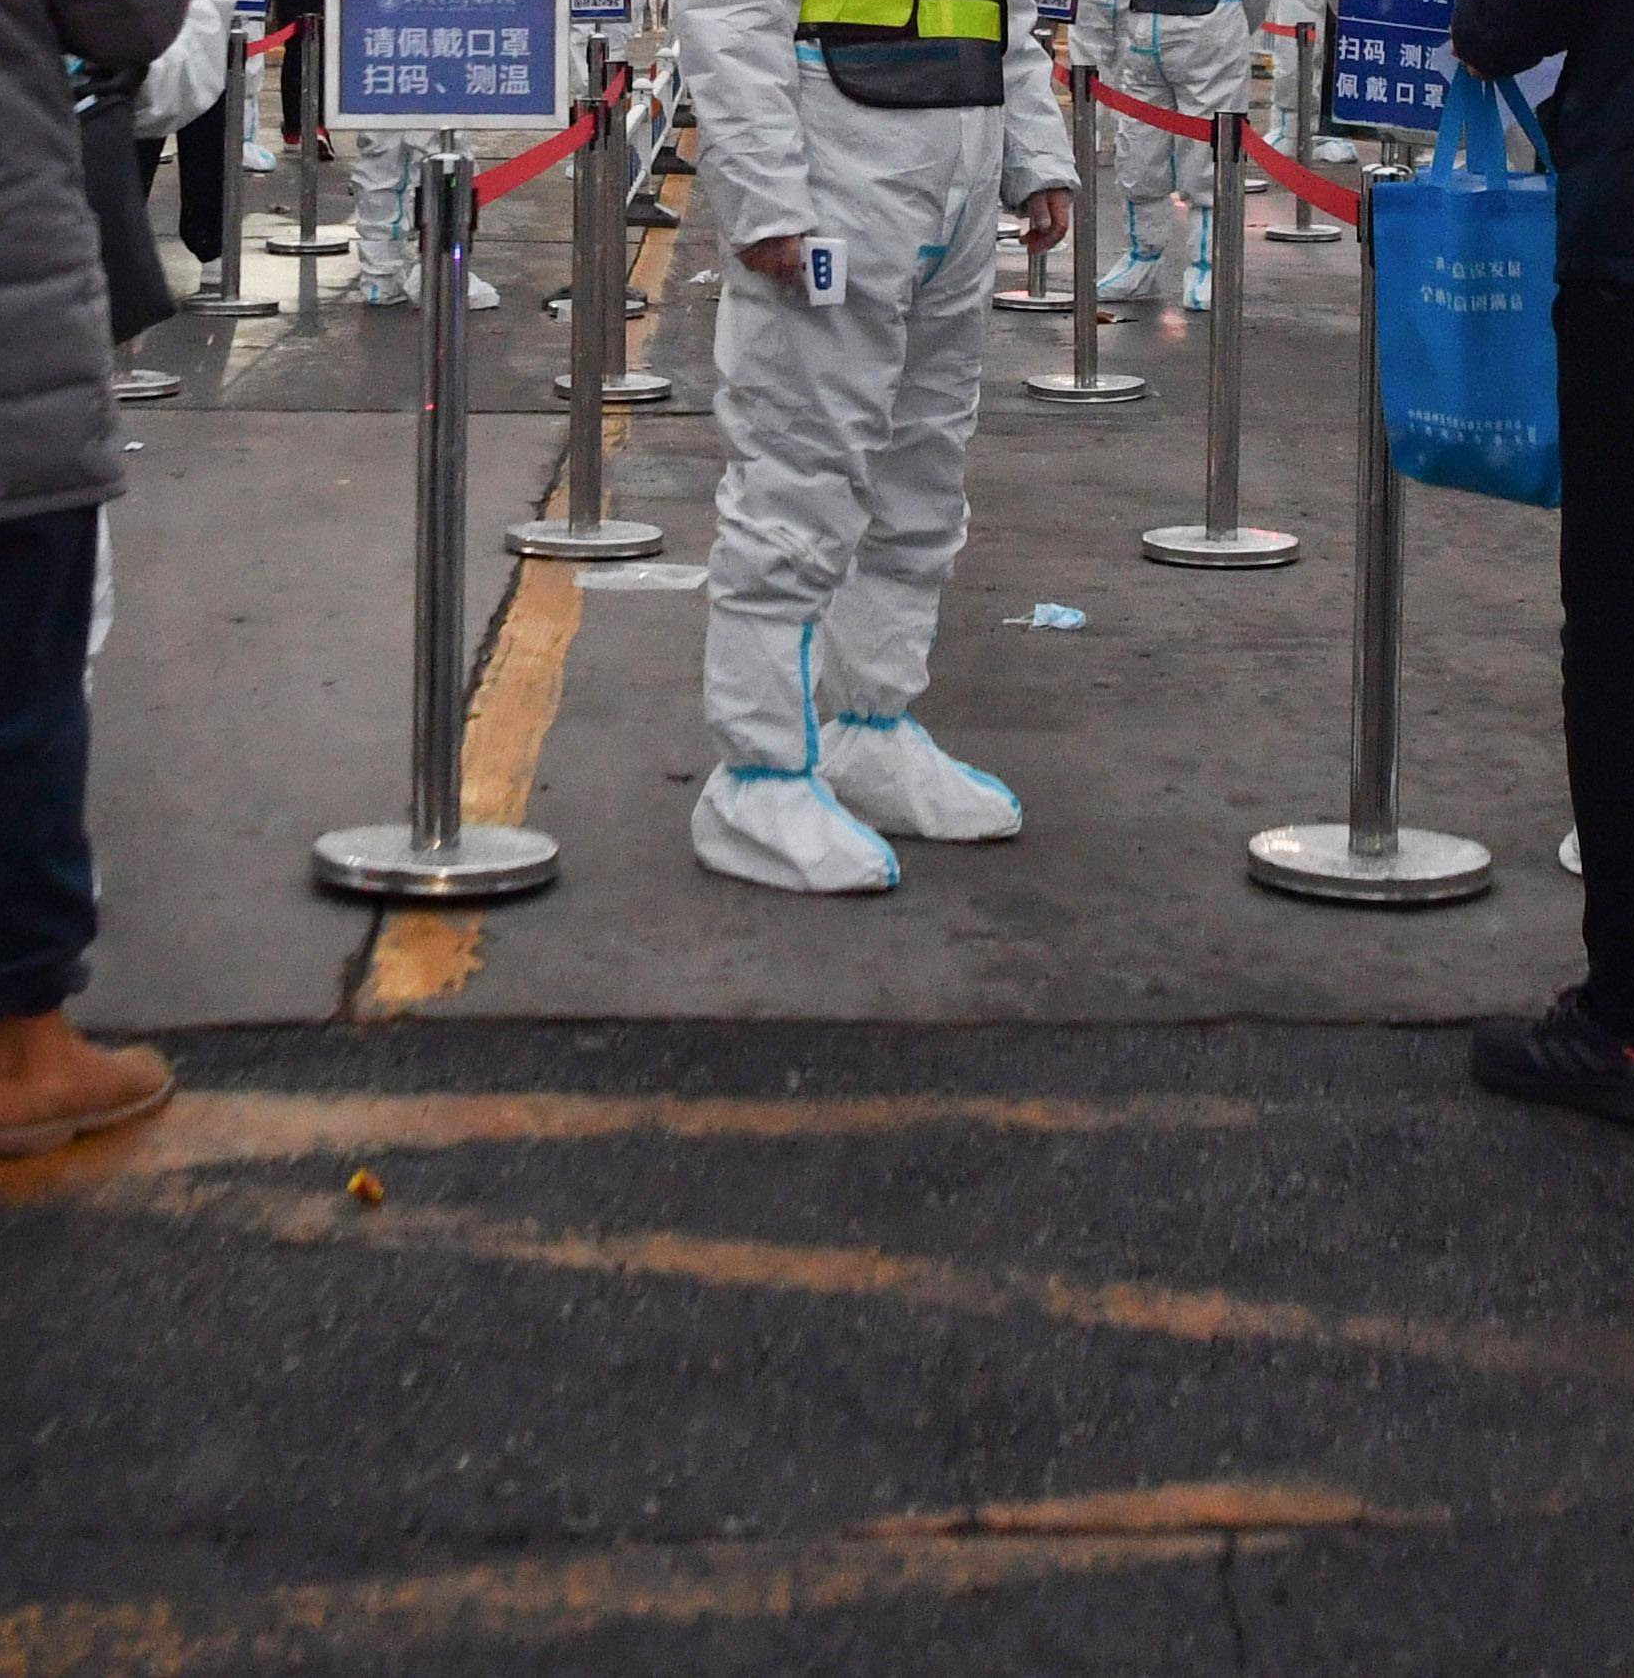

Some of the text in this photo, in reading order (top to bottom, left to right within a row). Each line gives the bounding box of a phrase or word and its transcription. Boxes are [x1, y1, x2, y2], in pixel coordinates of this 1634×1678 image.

[364, 26, 531, 58] 请佩戴口罩
[1338, 34, 1386, 66] 扫码
[363, 64, 531, 95] 扫码、测温
[1335, 72, 1445, 110] 佩戴口罩
